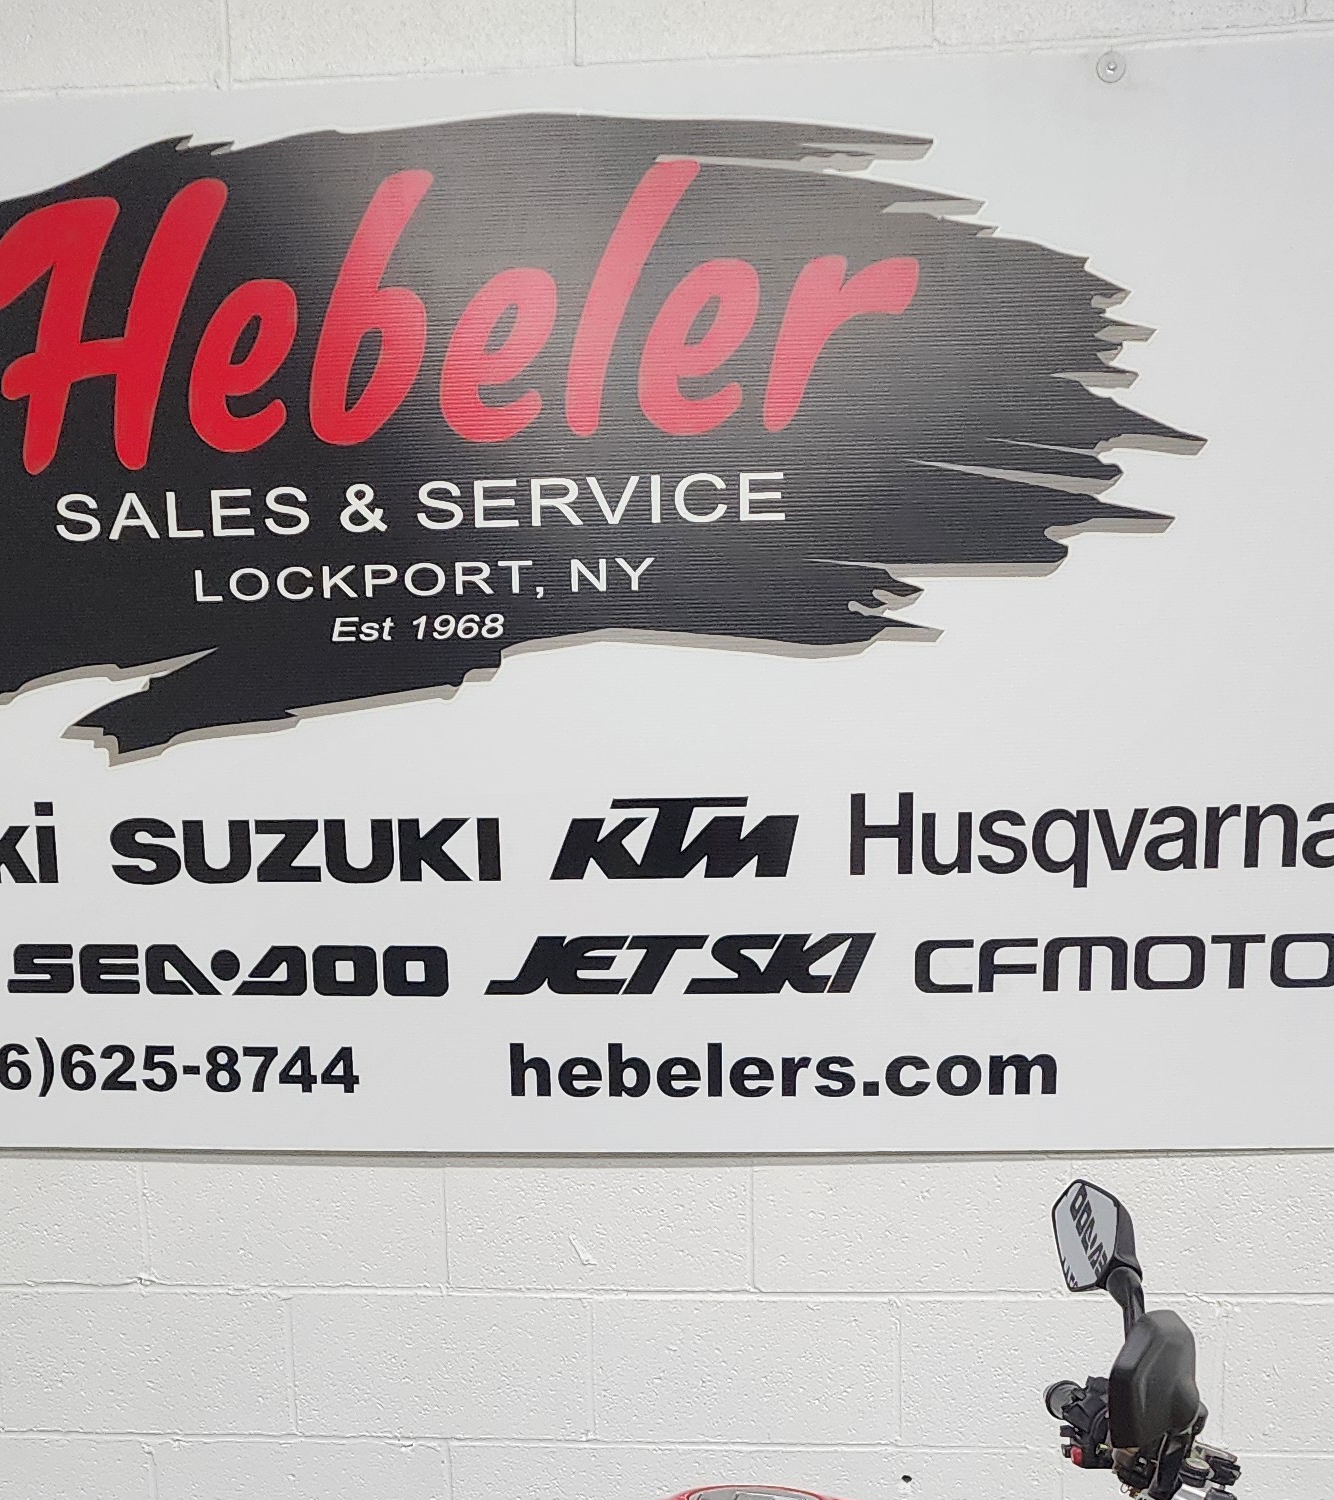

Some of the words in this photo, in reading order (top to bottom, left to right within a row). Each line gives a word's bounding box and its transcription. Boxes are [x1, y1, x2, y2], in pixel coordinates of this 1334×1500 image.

[55, 485, 310, 543] SALES
[339, 482, 389, 534] &
[433, 471, 787, 530] SERVICE
[194, 559, 546, 604] LOCKPORT,
[569, 556, 656, 594] NY
[331, 615, 395, 642] Est
[411, 612, 506, 641] 1968
[109, 817, 502, 886] SUZUKI
[549, 796, 800, 881] KTM
[483, 934, 710, 996] JET
[683, 932, 877, 995] SKI
[509, 1042, 1058, 1098] hebelers.com
